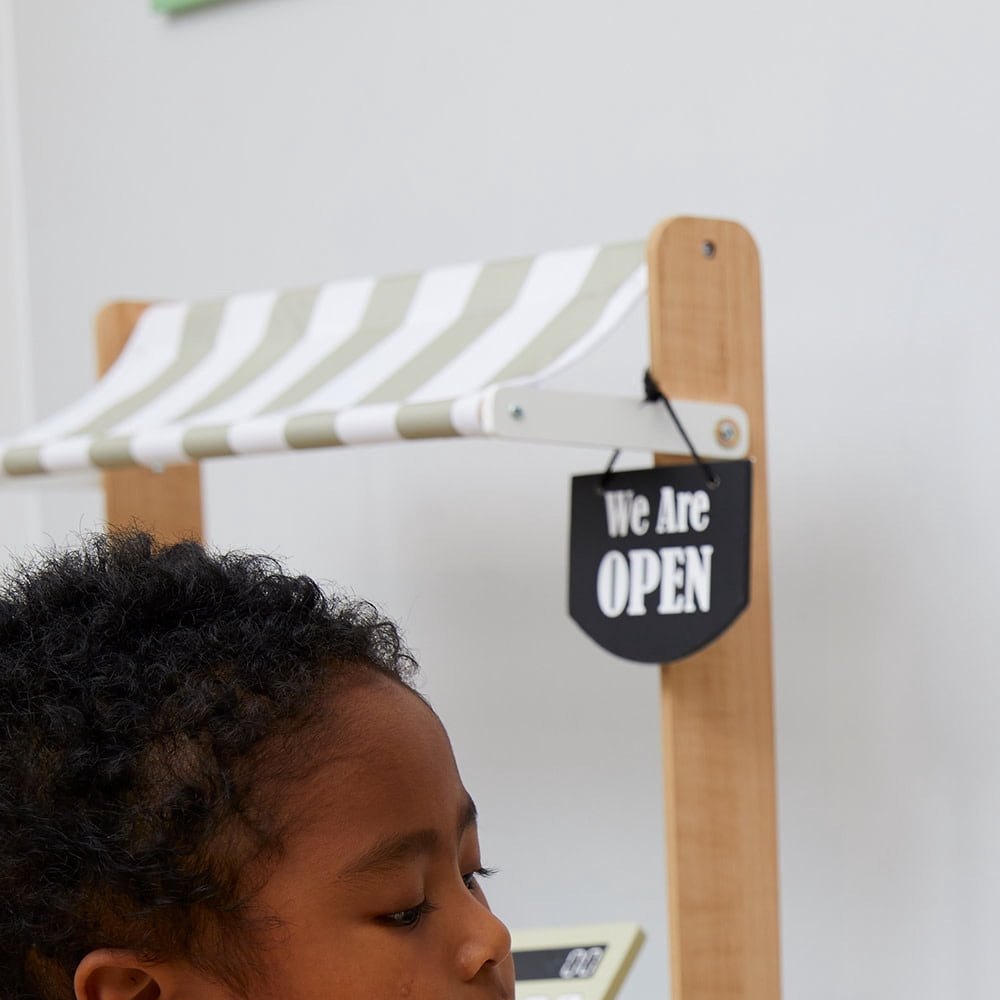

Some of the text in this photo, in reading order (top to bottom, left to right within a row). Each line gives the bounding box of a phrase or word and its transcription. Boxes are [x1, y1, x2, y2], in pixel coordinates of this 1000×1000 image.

[604, 486, 711, 538] We Are
[597, 545, 714, 618] OPEN
